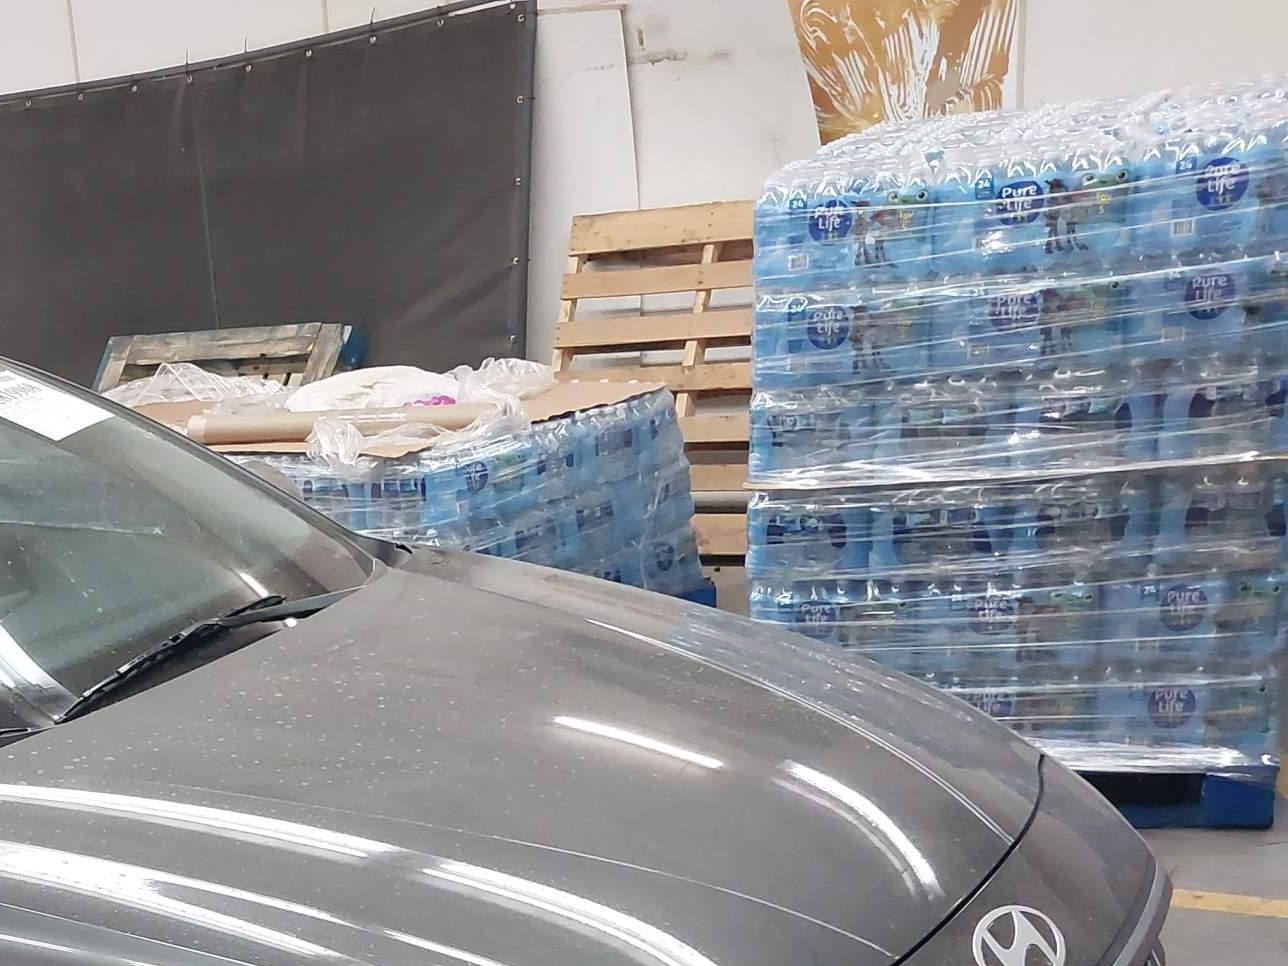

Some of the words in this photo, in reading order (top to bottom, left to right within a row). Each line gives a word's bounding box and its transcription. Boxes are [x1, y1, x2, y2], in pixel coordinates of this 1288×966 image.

[977, 179, 990, 188] 24
[1207, 177, 1236, 194] Life
[1002, 184, 1038, 199] Pure
[1007, 198, 1033, 212] Life
[818, 215, 841, 231] Life
[1192, 275, 1228, 289] Pure
[1195, 287, 1223, 303] Life
[1167, 590, 1200, 602] Pure
[1158, 699, 1184, 716] Life
